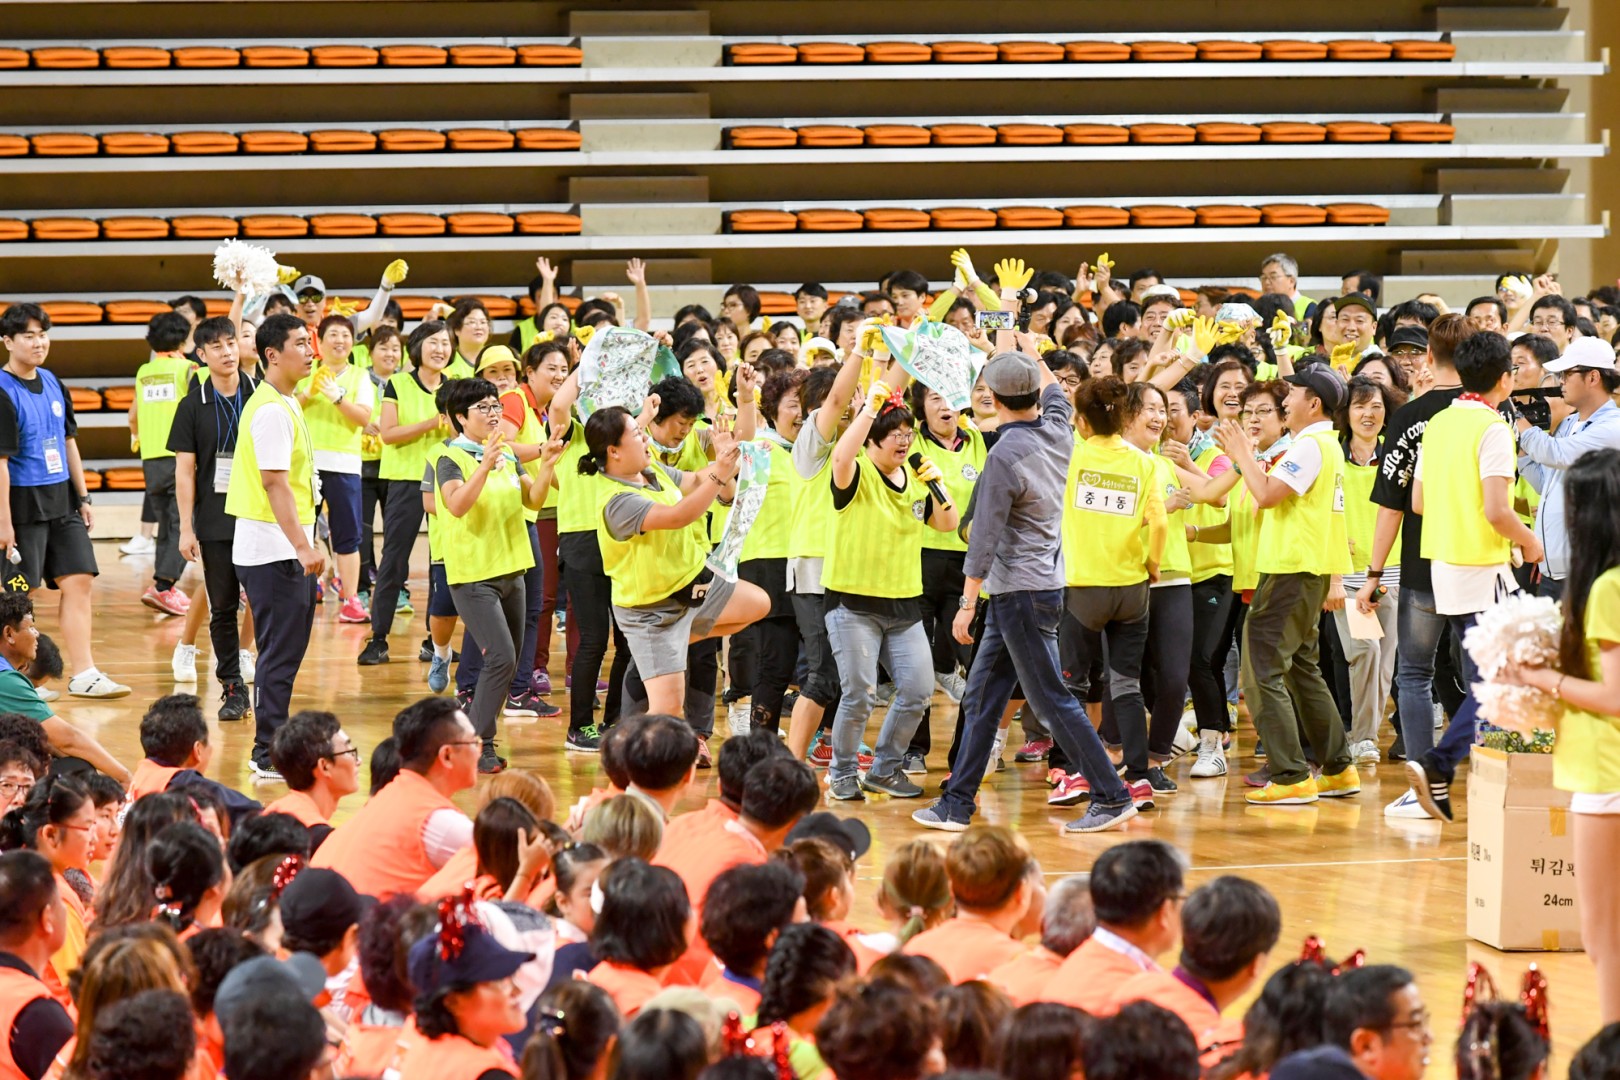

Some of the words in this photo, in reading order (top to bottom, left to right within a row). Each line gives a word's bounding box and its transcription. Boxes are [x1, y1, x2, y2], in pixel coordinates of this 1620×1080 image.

[1084, 491, 1095, 505] 중
[1104, 495, 1109, 507] 1
[1116, 496, 1126, 510] 동
[7, 574, 29, 591] 정
[1543, 893, 1573, 906] 24cm
